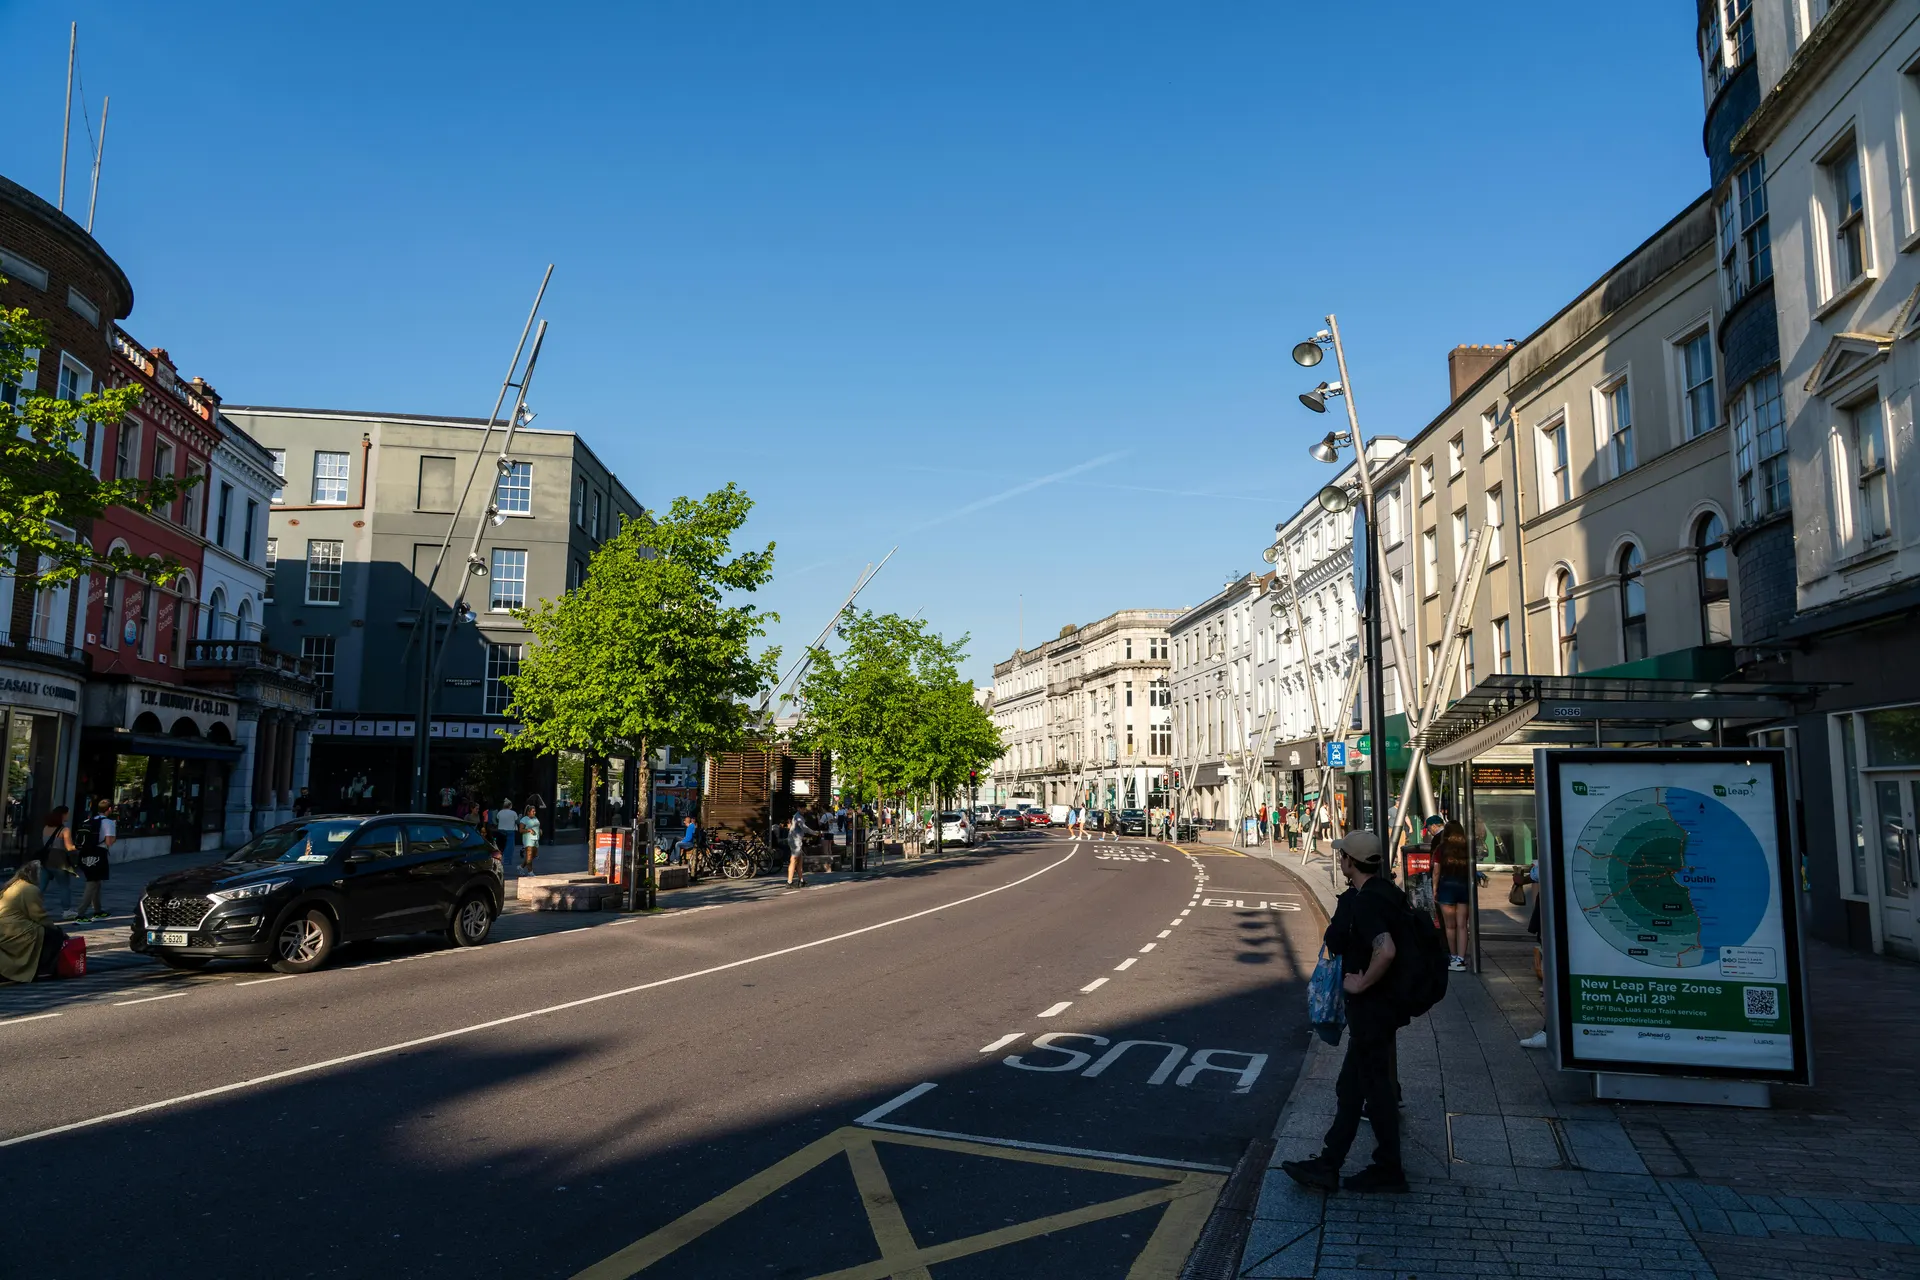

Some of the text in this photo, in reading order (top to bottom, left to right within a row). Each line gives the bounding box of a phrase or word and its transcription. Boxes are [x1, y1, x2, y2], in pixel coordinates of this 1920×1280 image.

[1553, 708, 1581, 717] 5086
[1728, 787, 1750, 796] Leap
[1683, 875, 1716, 884] Dublin
[1202, 898, 1302, 912] BUS
[1580, 978, 1722, 995] New Leap Fare Zones
[1581, 991, 1676, 1005] from April 28th
[1608, 1005, 1623, 1013] Bus,
[1658, 1007, 1677, 1015] Train
[1678, 1008, 1708, 1016] services
[1597, 1015, 1672, 1025] transportforireland.ie
[1002, 1032, 1269, 1094] BUS
